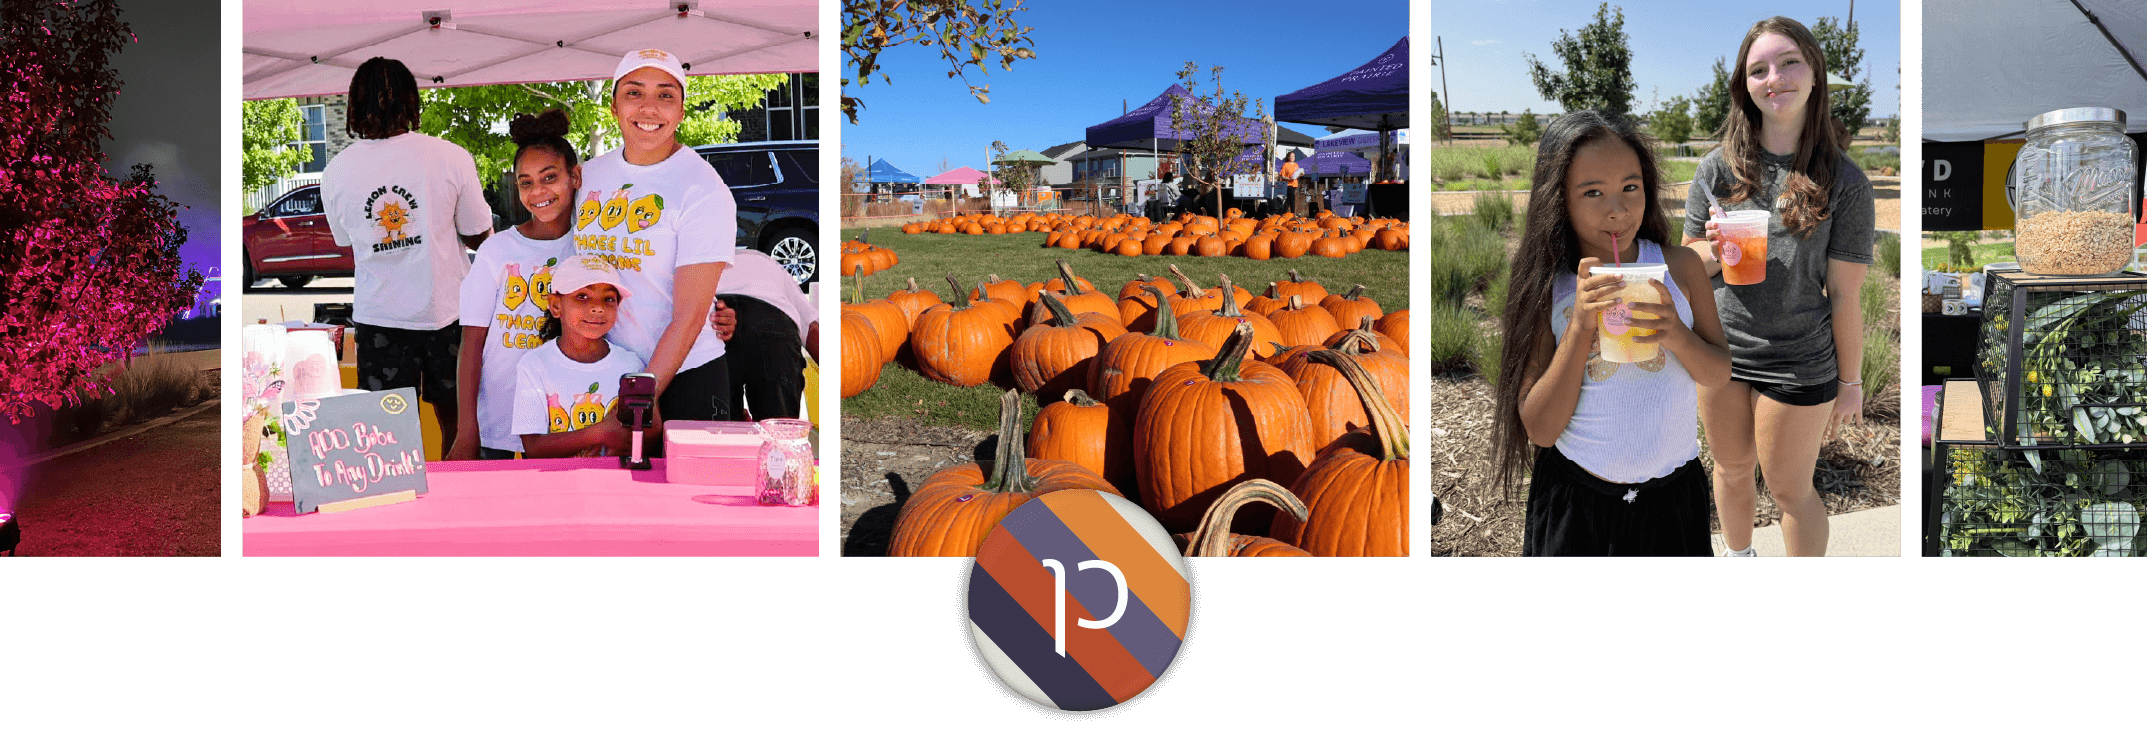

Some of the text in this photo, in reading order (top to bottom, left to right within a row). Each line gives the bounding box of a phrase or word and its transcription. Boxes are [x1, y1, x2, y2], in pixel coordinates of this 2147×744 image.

[1322, 138, 1356, 147] LAKEVIEW
[364, 185, 418, 219] LEMON CREW
[372, 235, 422, 253] SHINING
[621, 237, 656, 256] LIL
[352, 422, 398, 453] Boba
[313, 449, 423, 493] To Any Drink!
